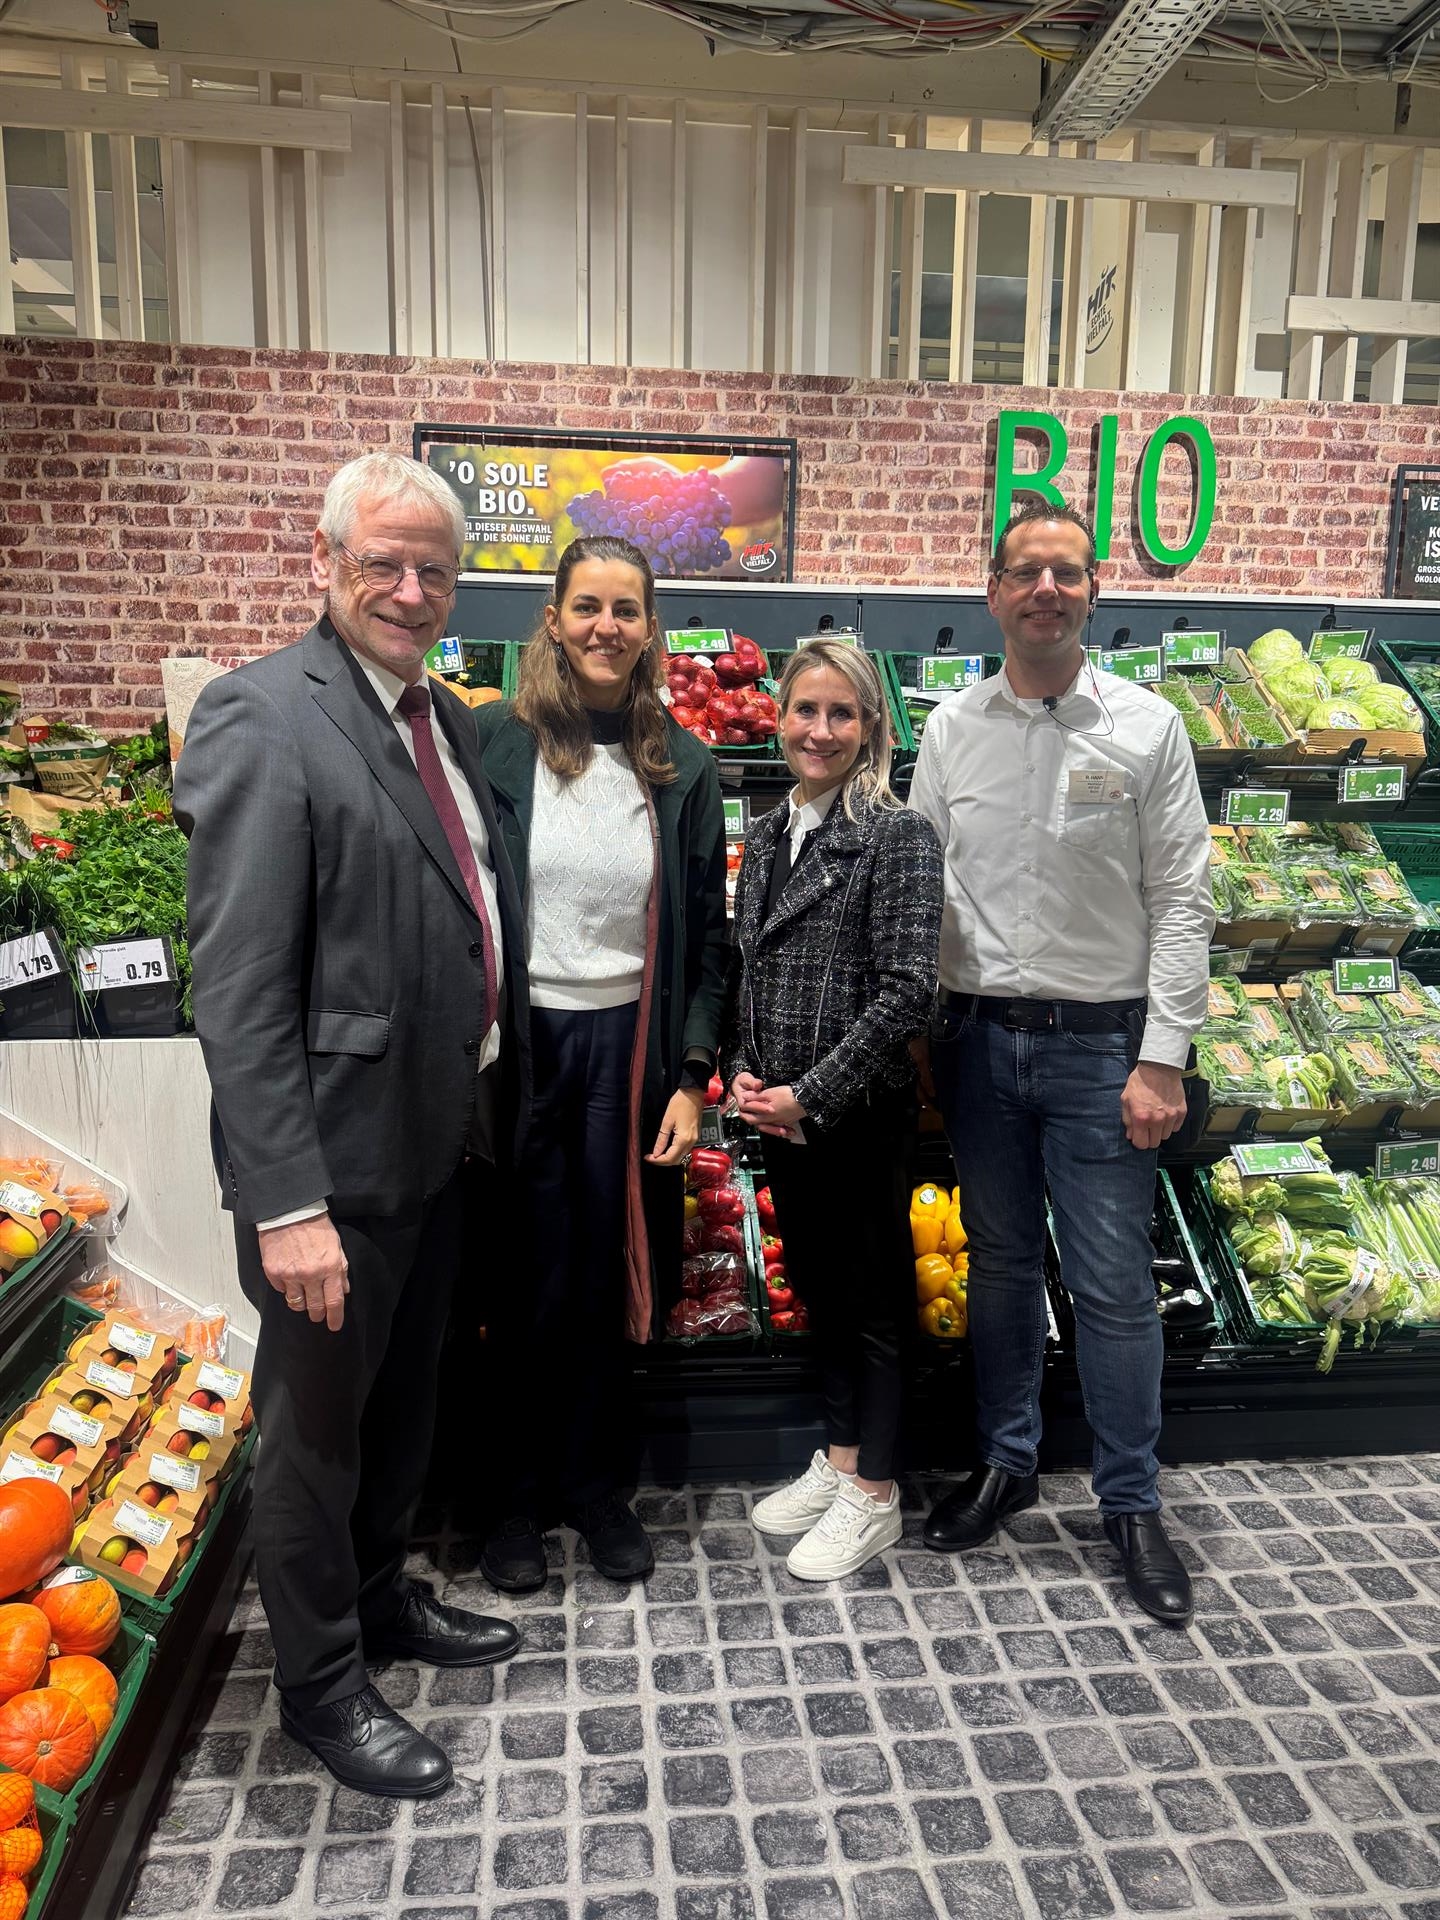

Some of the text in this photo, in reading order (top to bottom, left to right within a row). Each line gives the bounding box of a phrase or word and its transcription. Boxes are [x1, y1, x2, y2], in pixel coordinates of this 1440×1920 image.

[1087, 264, 1117, 322] HIT
[1091, 303, 1107, 328] ECHTE
[484, 461, 548, 488] SOLE
[991, 410, 1217, 566] BIO
[478, 488, 535, 516] BIO.
[475, 522, 507, 532] DIESER
[509, 523, 553, 534] AUSWAHL
[464, 532, 553, 544] EHT DIE SONNE AUF.
[744, 542, 774, 558] HIT
[1191, 647, 1216, 661] 0.69
[1337, 644, 1361, 657] 2.69
[433, 654, 459, 670] 3.99
[1133, 663, 1158, 679] 1.39
[954, 672, 979, 686] 5.90
[1375, 782, 1400, 797] 2.29
[1258, 807, 1284, 822] 2.29
[724, 816, 740, 831] 99
[18, 954, 54, 977] 1.79
[126, 960, 162, 980] 0.79
[1216, 961, 1243, 972] 2.29
[1367, 975, 1392, 989] 2.29
[1278, 1155, 1309, 1169] 3.49
[1411, 1156, 1437, 1173] 2.49
